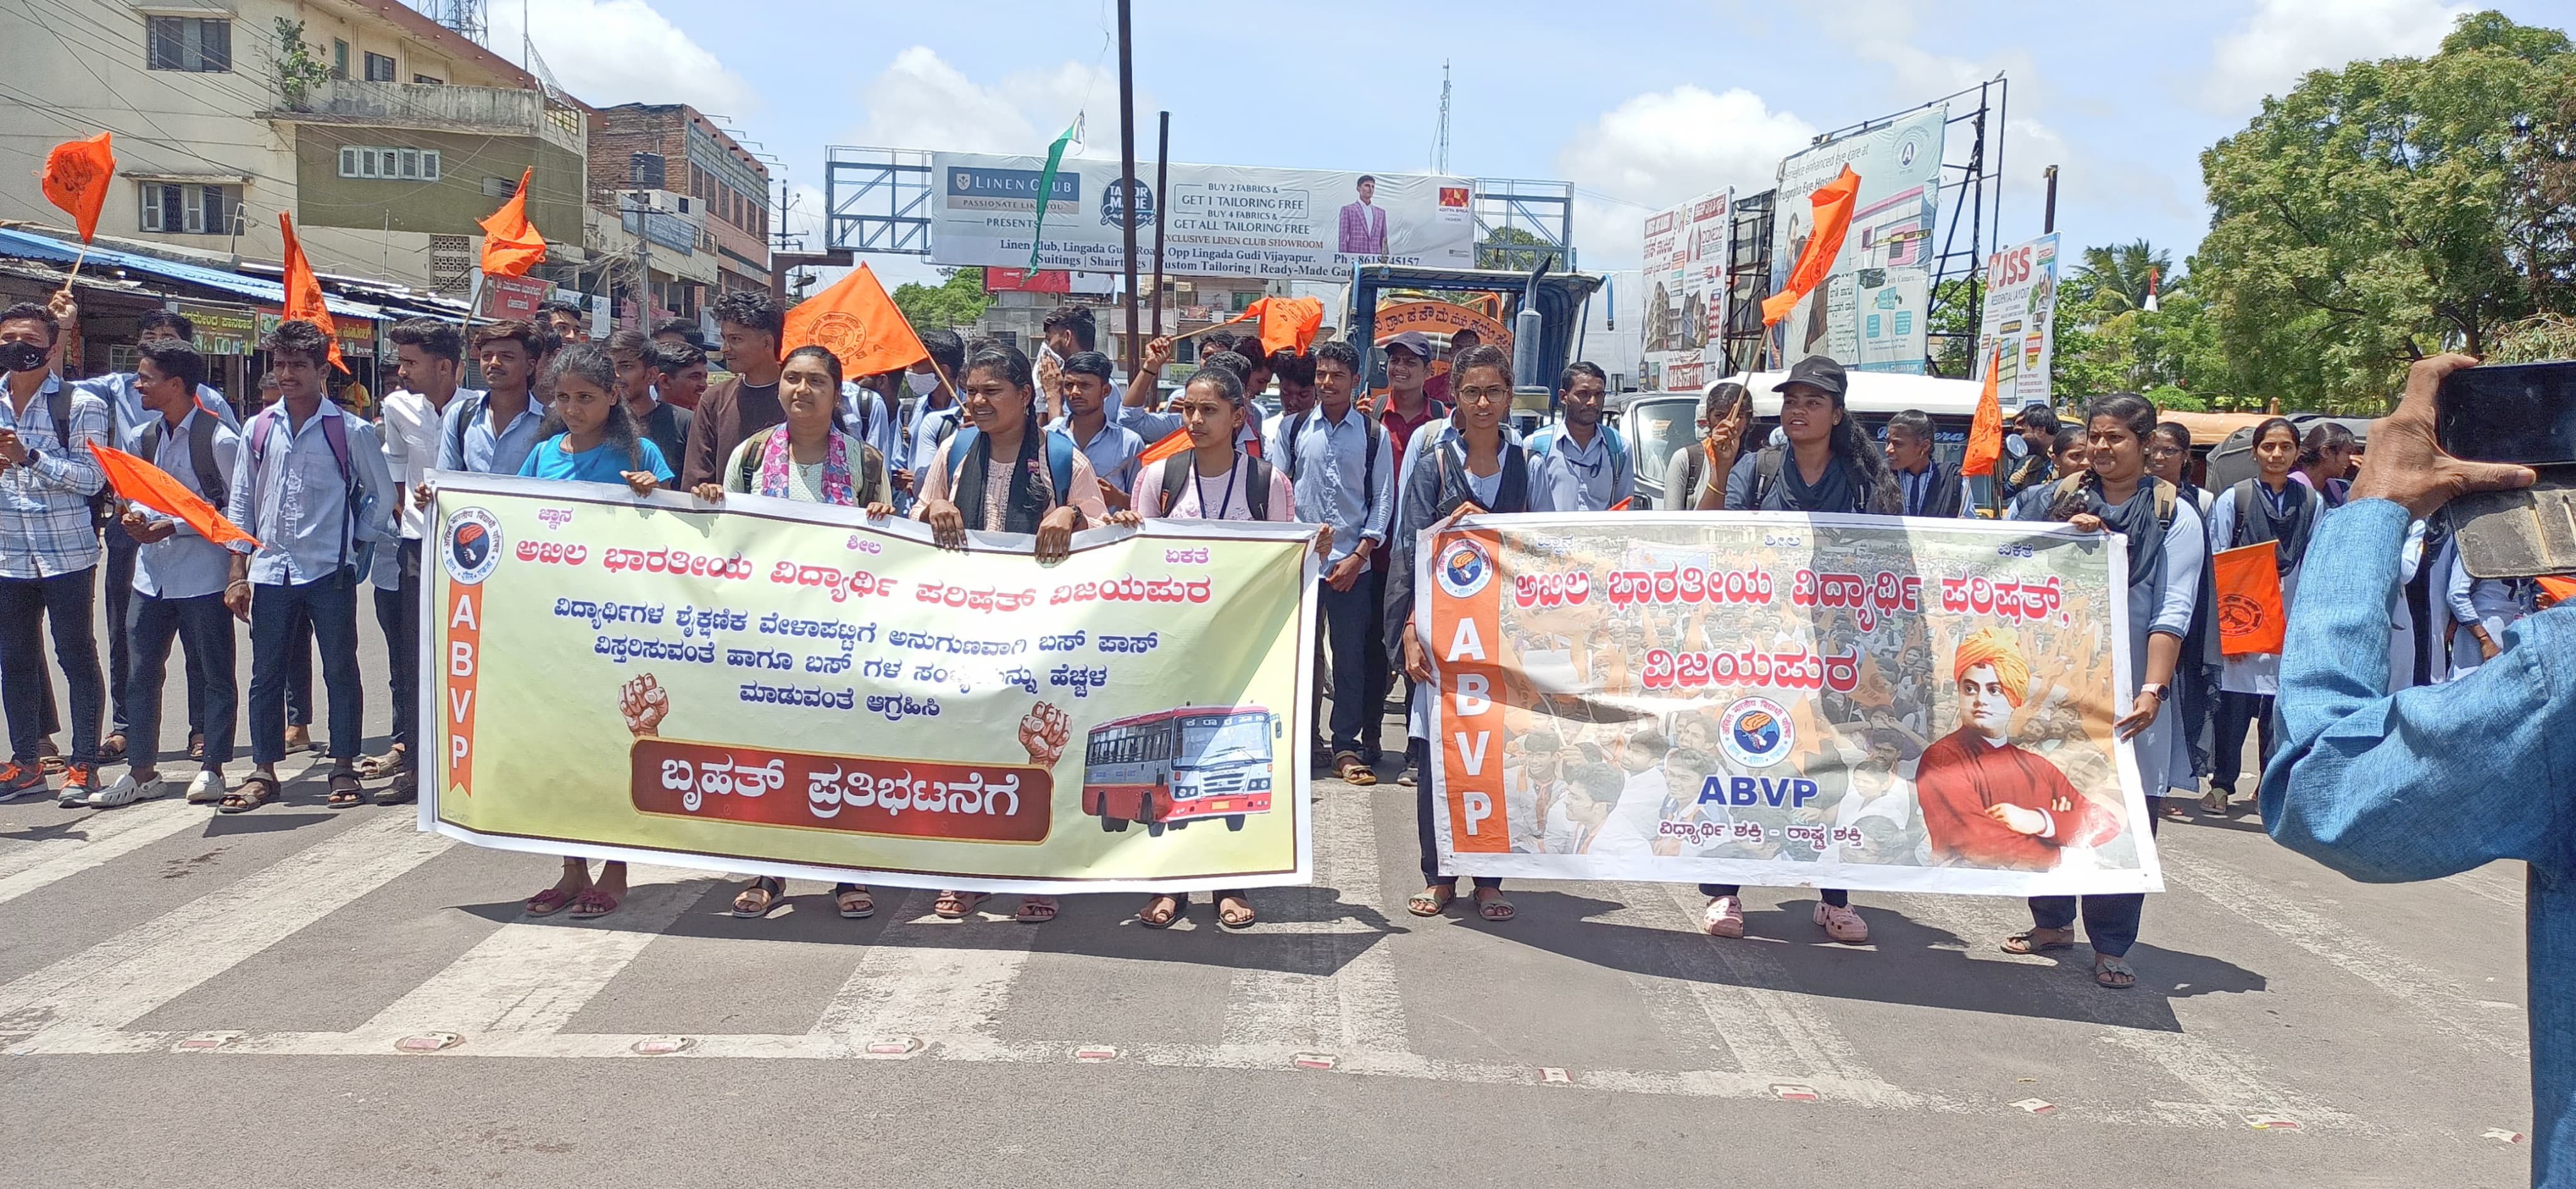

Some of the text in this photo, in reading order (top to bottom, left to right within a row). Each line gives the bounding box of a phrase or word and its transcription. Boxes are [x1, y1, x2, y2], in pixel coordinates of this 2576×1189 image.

[1848, 147, 1861, 161] care
[1862, 144, 1869, 157] at
[976, 175, 1072, 192] LINEN CUB
[1109, 185, 1148, 197] TAOR
[1208, 183, 1226, 191] BUY
[1236, 184, 1269, 193] FABRICS
[1777, 184, 1802, 202] nugraha
[1803, 180, 1814, 194] Eye
[963, 199, 1016, 209] PASSIONATE
[1110, 196, 1147, 209] MDE
[1182, 195, 1204, 206] GET
[1217, 196, 1275, 209] TAILORING
[1279, 199, 1304, 210] FREE
[1174, 219, 1310, 235] GET ALL TAILORING FREE
[1236, 211, 1269, 220] FABRICS
[1001, 240, 1030, 250] Linen
[1063, 242, 1105, 255] Lingada
[1136, 246, 1164, 257] Roa,
[1168, 247, 1189, 260] Opp
[1192, 248, 1233, 260] Lingada
[1236, 250, 1261, 260] Gudi
[1263, 252, 1316, 265] Vijayapur.
[1334, 254, 1347, 264] Ph
[1164, 234, 1323, 249] XCLUSIVE LINEN CLUB SHOWROOM
[1037, 253, 1080, 267] Suitings
[1090, 256, 1146, 270] Shairtgs
[1161, 260, 1197, 270] ustom
[1201, 261, 1251, 274] Tailoring
[1260, 264, 1328, 277] Ready-Made
[1999, 246, 2030, 287] JSS
[538, 507, 1208, 564] ಜ್ಞಾನ ಶೀಲ ಏಕತೆ
[1764, 534, 1801, 548] ಶೀಲ
[1998, 542, 2034, 558] ಏಕತೆ
[516, 538, 1211, 614] ಅಖಿಲ ಭಾರತೀಯ ವಿದ್ಯಾರ್ಥಿ ಪರಿಷತ್ ವಿಜಯಪುರ
[1514, 560, 2070, 632] ಅಖಿಲ ಭಾರತೀಯ ವಿದ್ಯಾರ್ಥಿ ಪರಿಷತ್,
[554, 598, 1158, 656] ವಿದ್ಯಾರ್ಥಿಗಳ ಶೈಕ್ಷಣಿಕ ವೇಳಾಪಟ್ಟಿಗೆ ಅನುಗುಣವಾಗಿ ಬಸ್ ಪಾಸ್
[594, 633, 716, 664] ವಿಸ್ತರಿಸುವಂತೆ
[727, 646, 793, 671] ಹಾಗೂ
[805, 653, 852, 674] ಬಸ್
[864, 656, 902, 678] ಗಳ
[1050, 663, 1108, 698] ಹೆಚ್ಚಳ
[1641, 641, 1859, 691] ವಿಜಯಪುರ
[450, 594, 477, 769] ABVP
[740, 680, 940, 720] ಮಾಡುವಂತೆ ಆಗ್ರಹಿಸಿ
[1447, 617, 1492, 836] ABVP
[661, 753, 1019, 818] ಬೃಹತ್ ಪ್ರತಿಭಟನೆಗೆ
[1698, 776, 1818, 809] ABVP
[1734, 823, 1762, 843] ಶಕ್ತಿ
[1834, 827, 1862, 847] ಶಕ್ತಿ
